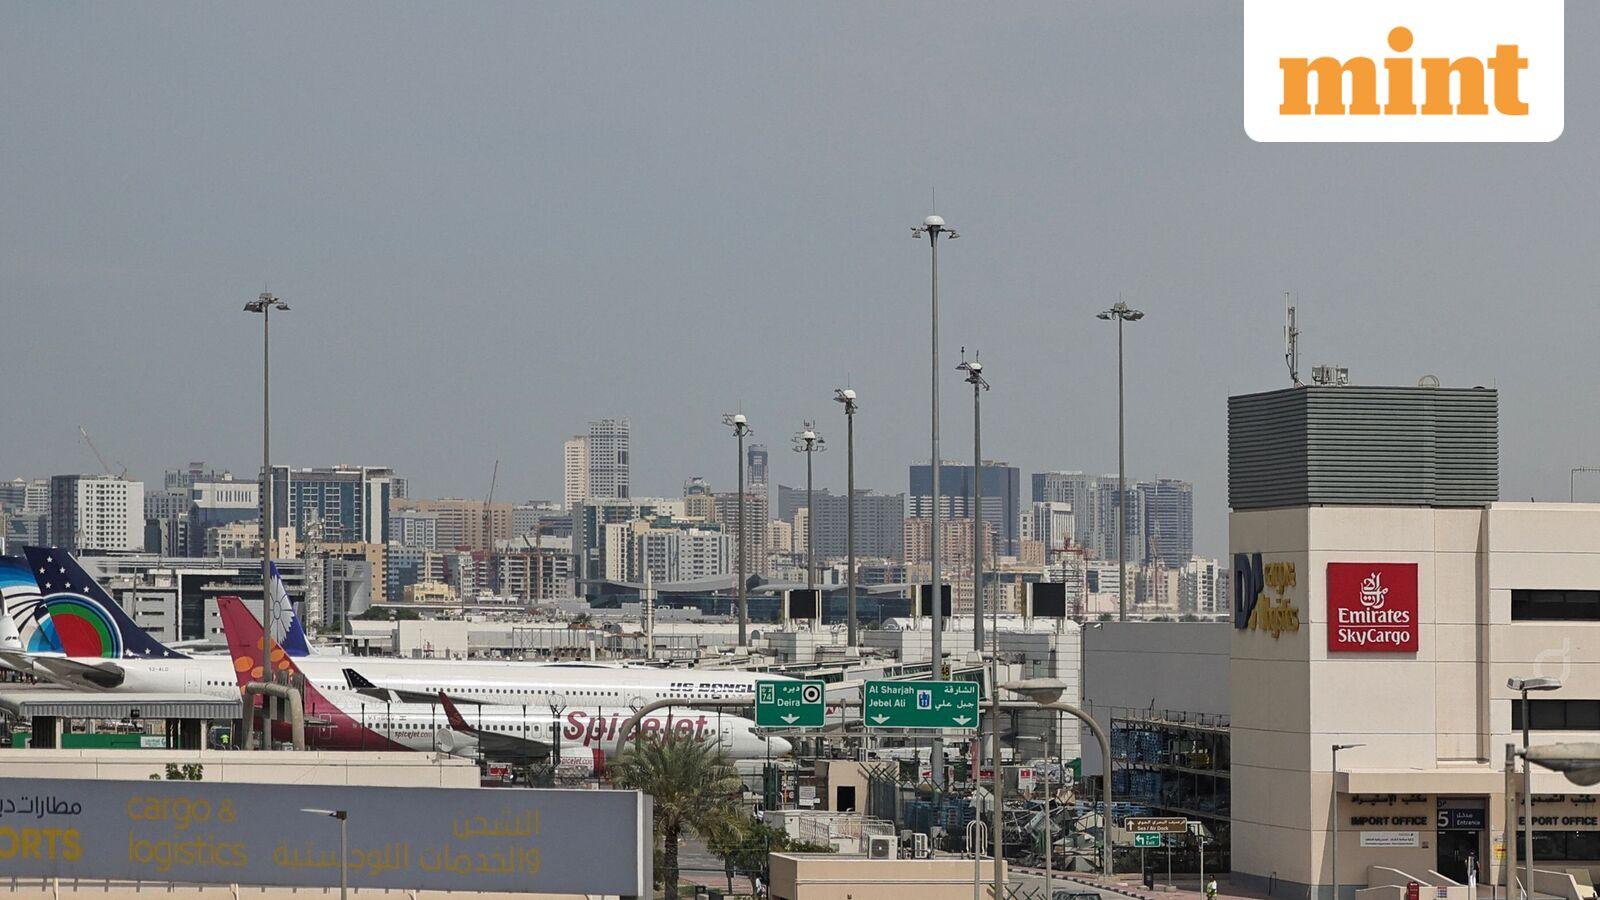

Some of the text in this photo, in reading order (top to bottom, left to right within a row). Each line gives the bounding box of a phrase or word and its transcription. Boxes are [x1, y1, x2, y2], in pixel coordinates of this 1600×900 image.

[1338, 607, 1410, 623] Emirates
[1338, 628, 1410, 645] SkyCargo
[869, 685, 914, 695] Al Sharjah
[944, 685, 975, 695] الشارقة
[777, 698, 800, 707] Deira
[868, 699, 906, 707] Jebel Ali
[17, 795, 82, 819] مطارات
[126, 795, 238, 830] cargo &
[1351, 816, 1428, 826] IMPORT OFFICE
[1437, 811, 1449, 828] 5
[1518, 816, 1598, 826] EPORT OFFICE
[128, 831, 249, 873] logistics
